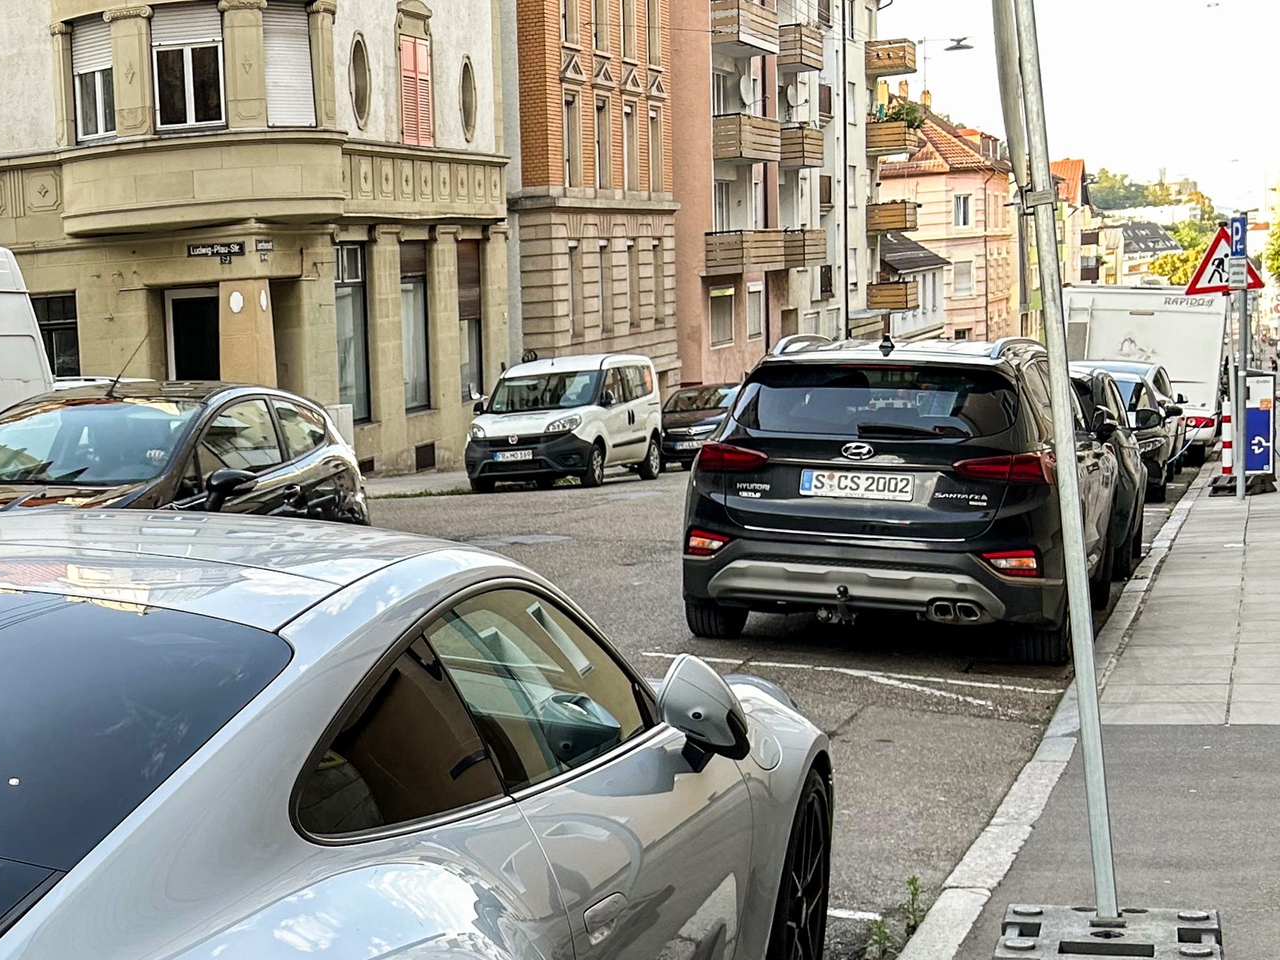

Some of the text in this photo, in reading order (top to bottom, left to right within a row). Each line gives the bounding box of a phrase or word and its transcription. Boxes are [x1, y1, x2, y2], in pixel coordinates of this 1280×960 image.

[1232, 221, 1241, 253] P
[1163, 296, 1206, 306] RAPIDO
[736, 482, 770, 491] HYUNDAI
[813, 473, 910, 494] S CS 2002
